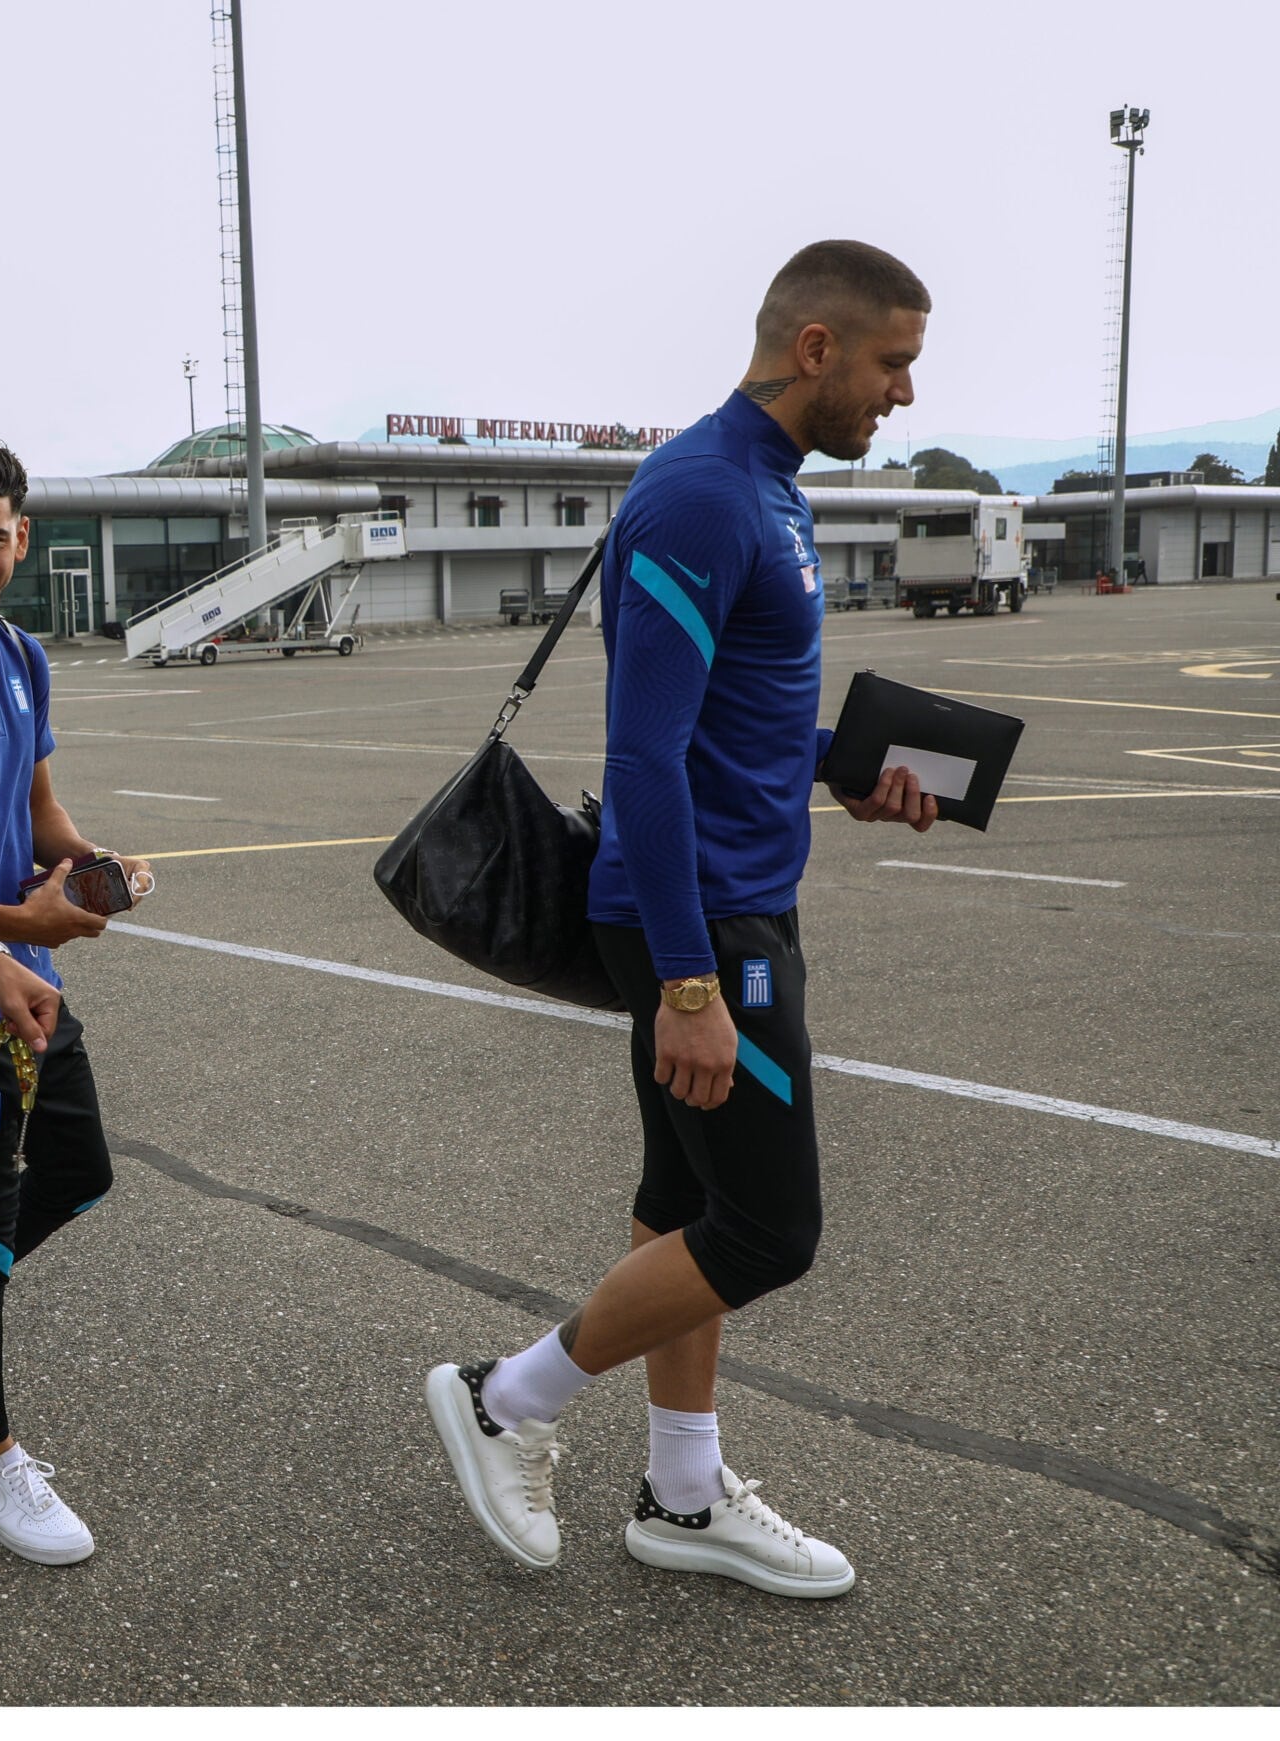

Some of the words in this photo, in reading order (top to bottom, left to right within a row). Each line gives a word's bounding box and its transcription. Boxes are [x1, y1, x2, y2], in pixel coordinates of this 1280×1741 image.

[387, 414, 462, 438] BATUMI
[477, 418, 622, 444] INTERNATIONAL
[638, 427, 684, 447] AIRP
